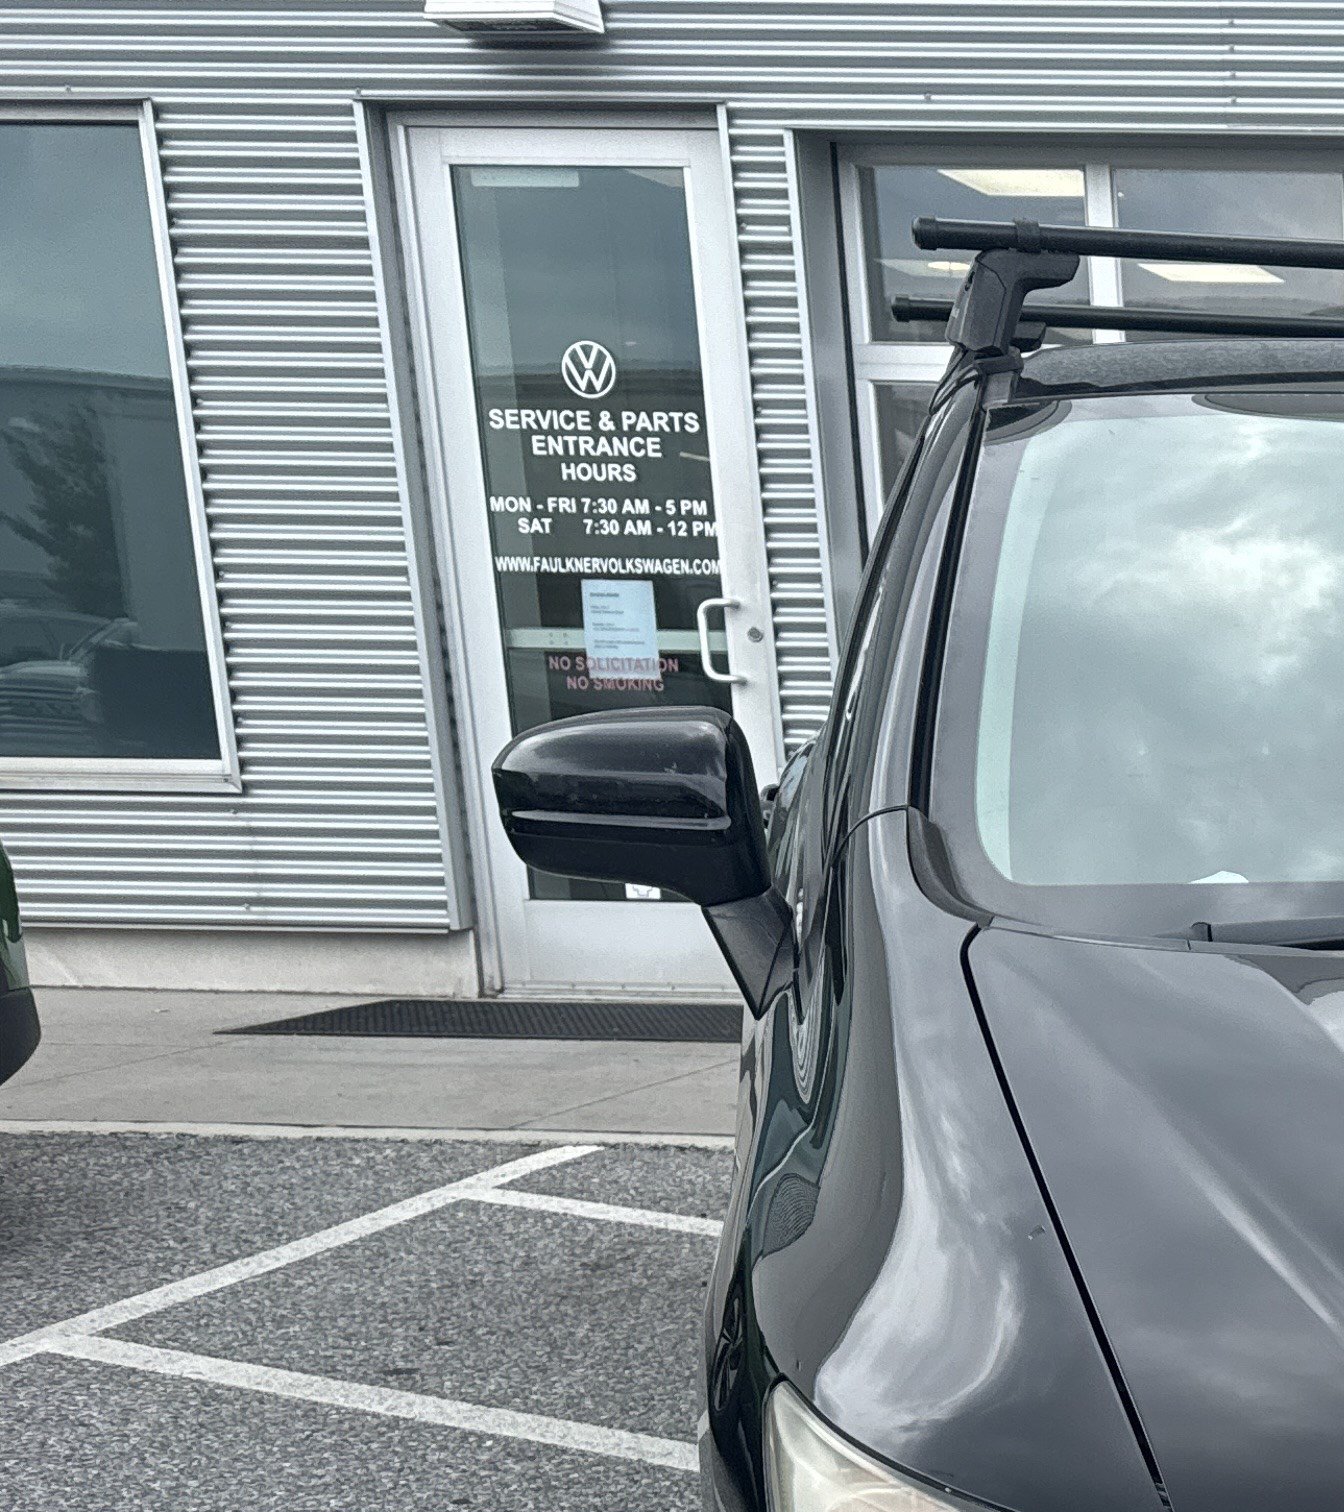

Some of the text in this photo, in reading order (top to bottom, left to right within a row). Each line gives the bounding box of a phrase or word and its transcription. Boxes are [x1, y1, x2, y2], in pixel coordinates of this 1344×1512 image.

[488, 408, 700, 433] SERVICE & PARTS
[531, 435, 663, 458] ENTRANCE
[560, 462, 638, 482] HOURS
[489, 496, 531, 513] MON
[547, 496, 577, 514] FRI
[580, 497, 618, 514] 7:30
[621, 498, 650, 514] AM
[665, 498, 677, 516] 5
[680, 499, 708, 516] PM
[517, 517, 553, 534] SAT
[582, 519, 621, 535] 7:30
[623, 519, 653, 536] AM
[667, 519, 688, 537] 12
[691, 520, 719, 537] PM
[495, 556, 721, 576] WWW.FAULKNERVOLKSWAGEN.COM
[548, 656, 679, 673] NO SOLICITATION
[566, 675, 665, 692] NO SMOKING
